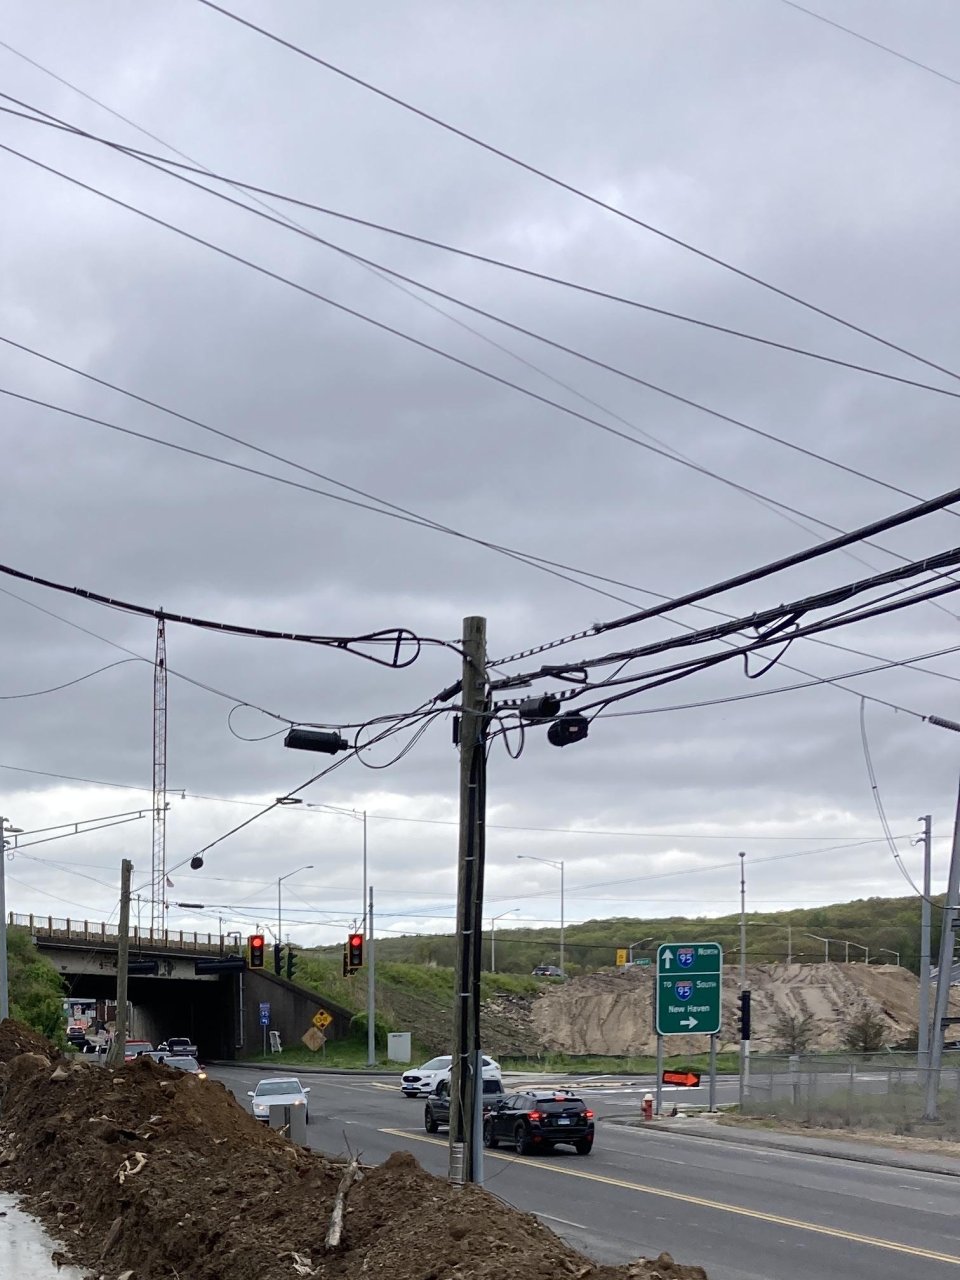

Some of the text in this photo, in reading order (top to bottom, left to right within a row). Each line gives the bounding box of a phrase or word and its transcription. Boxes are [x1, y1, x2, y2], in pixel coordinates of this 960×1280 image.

[680, 954, 693, 963] 95
[677, 986, 690, 995] 95
[668, 1005, 710, 1013] New Haven
